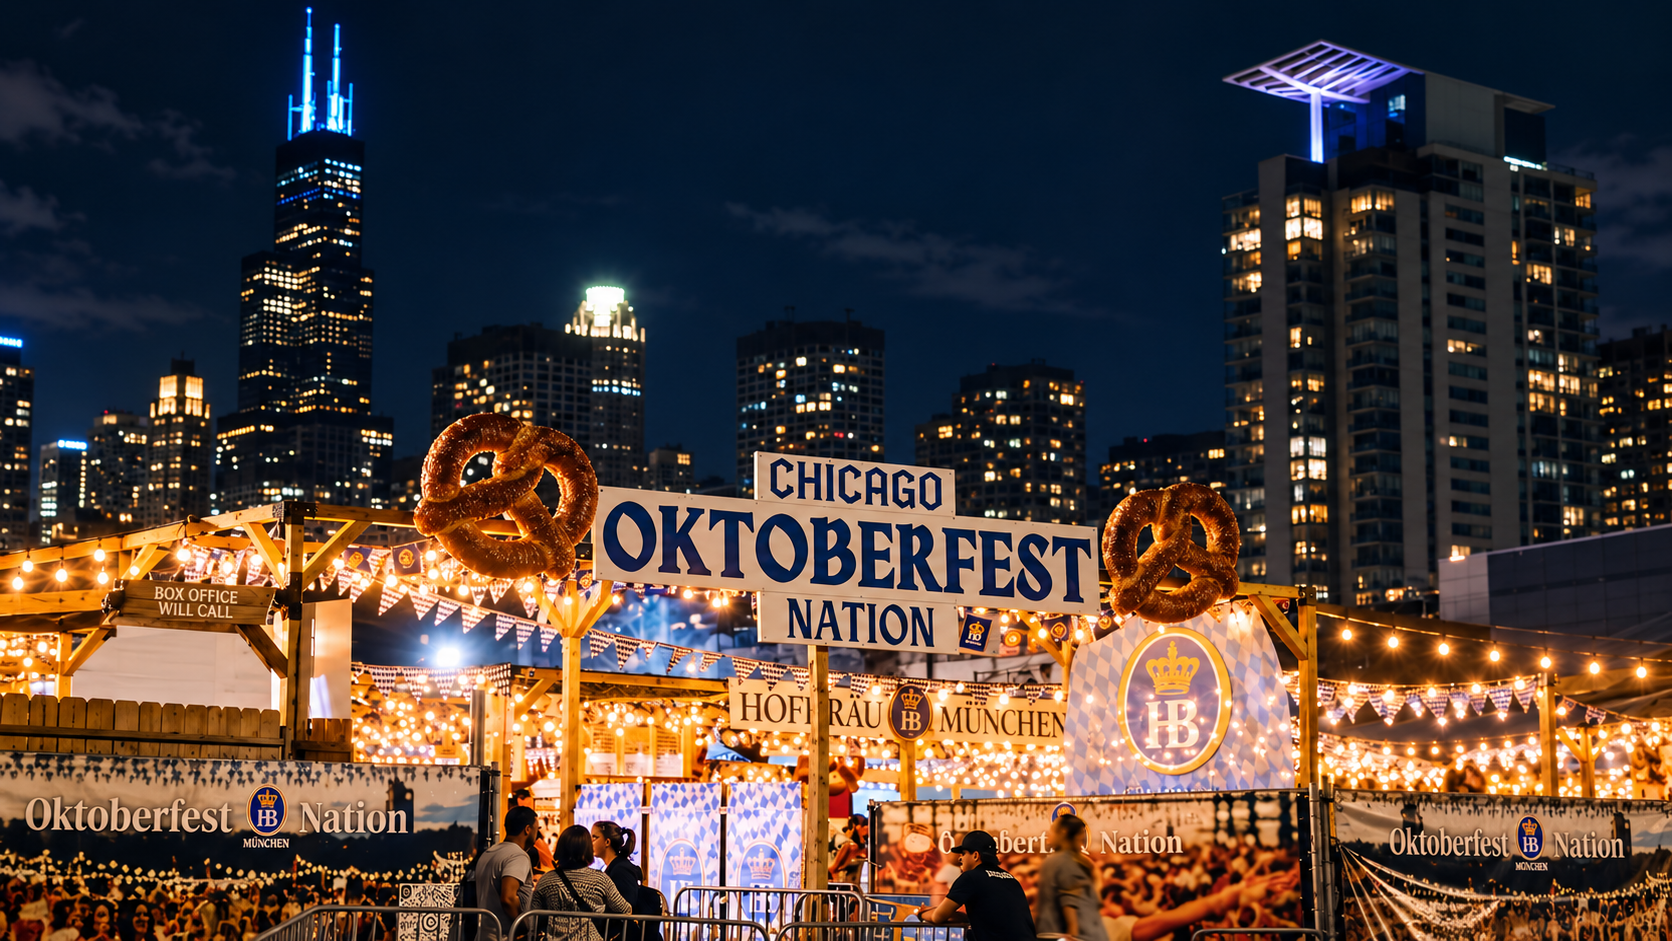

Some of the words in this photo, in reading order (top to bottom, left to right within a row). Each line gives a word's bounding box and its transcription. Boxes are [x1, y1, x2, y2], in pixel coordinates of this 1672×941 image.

[770, 458, 943, 511] CHICAGO
[603, 501, 1091, 604] OKTOBERFEST
[154, 586, 185, 601] BOX
[188, 588, 239, 604] OFFICE
[158, 601, 194, 616] WILL
[197, 604, 233, 619] CALL
[787, 598, 935, 648] NATION
[901, 710, 922, 731] HB
[1145, 699, 1200, 749] HB
[25, 796, 233, 834] Oktoberfest
[256, 809, 278, 828] HB
[299, 801, 409, 834] Nation
[243, 836, 290, 849] MÜNCHEN
[1100, 829, 1184, 855] Nation
[1389, 827, 1510, 858] Oktoberfest
[1522, 836, 1539, 853] HB
[1553, 831, 1625, 859] Nation
